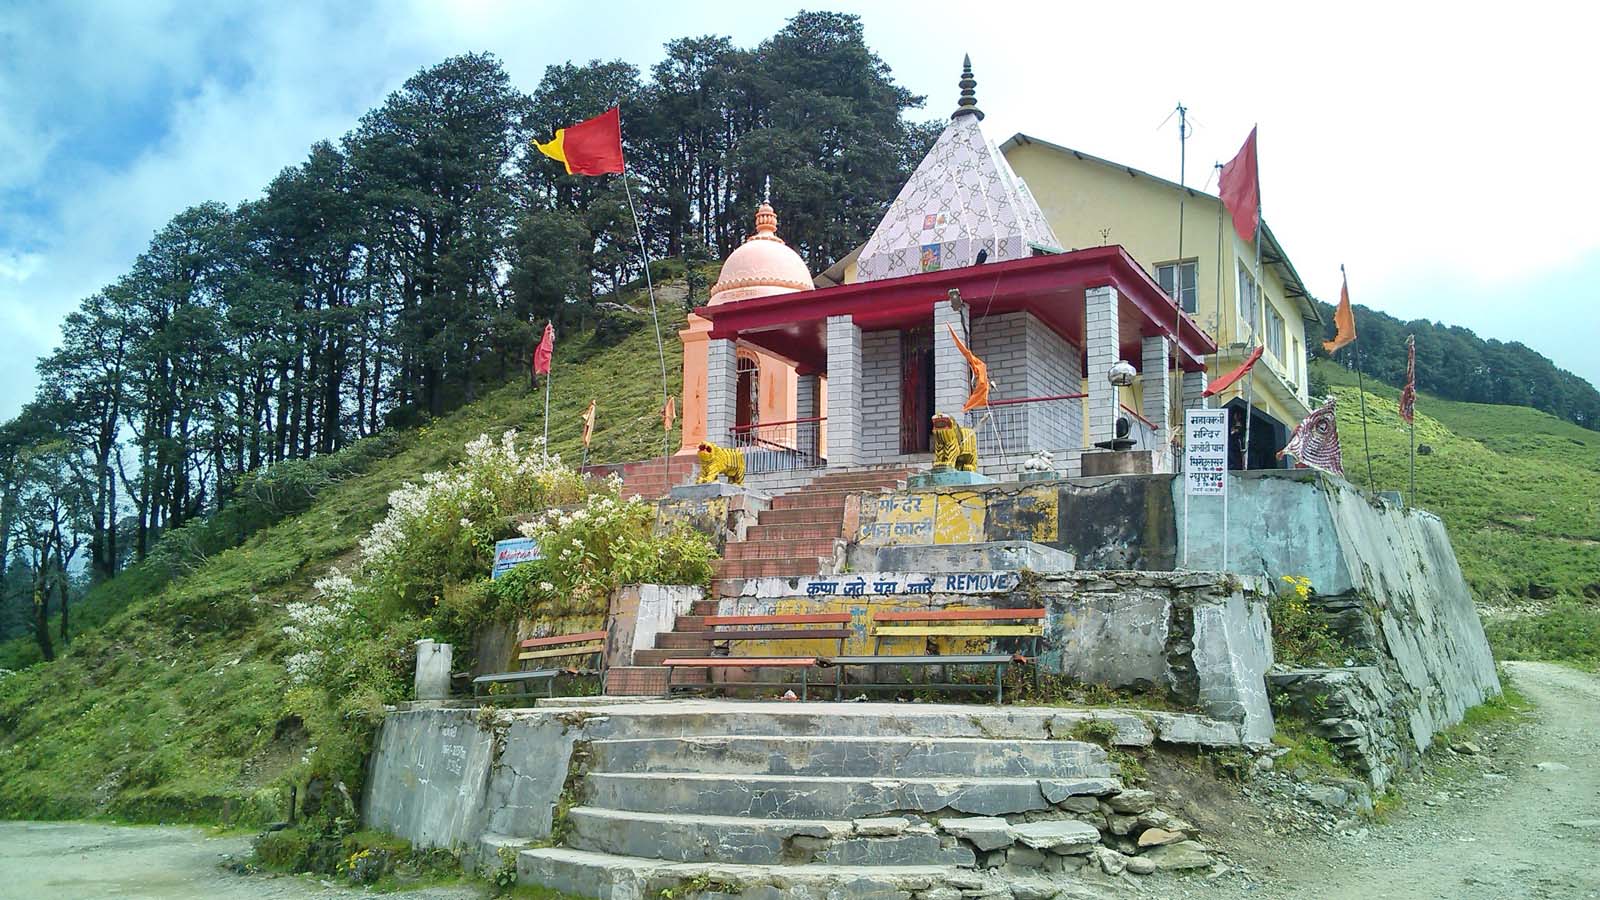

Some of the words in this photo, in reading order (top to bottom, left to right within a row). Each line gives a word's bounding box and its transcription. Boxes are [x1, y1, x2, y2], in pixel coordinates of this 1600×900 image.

[1190, 412, 1225, 424] महाकाली
[1192, 426, 1222, 439] मन्दिर
[946, 574, 1008, 591] REMOVE
